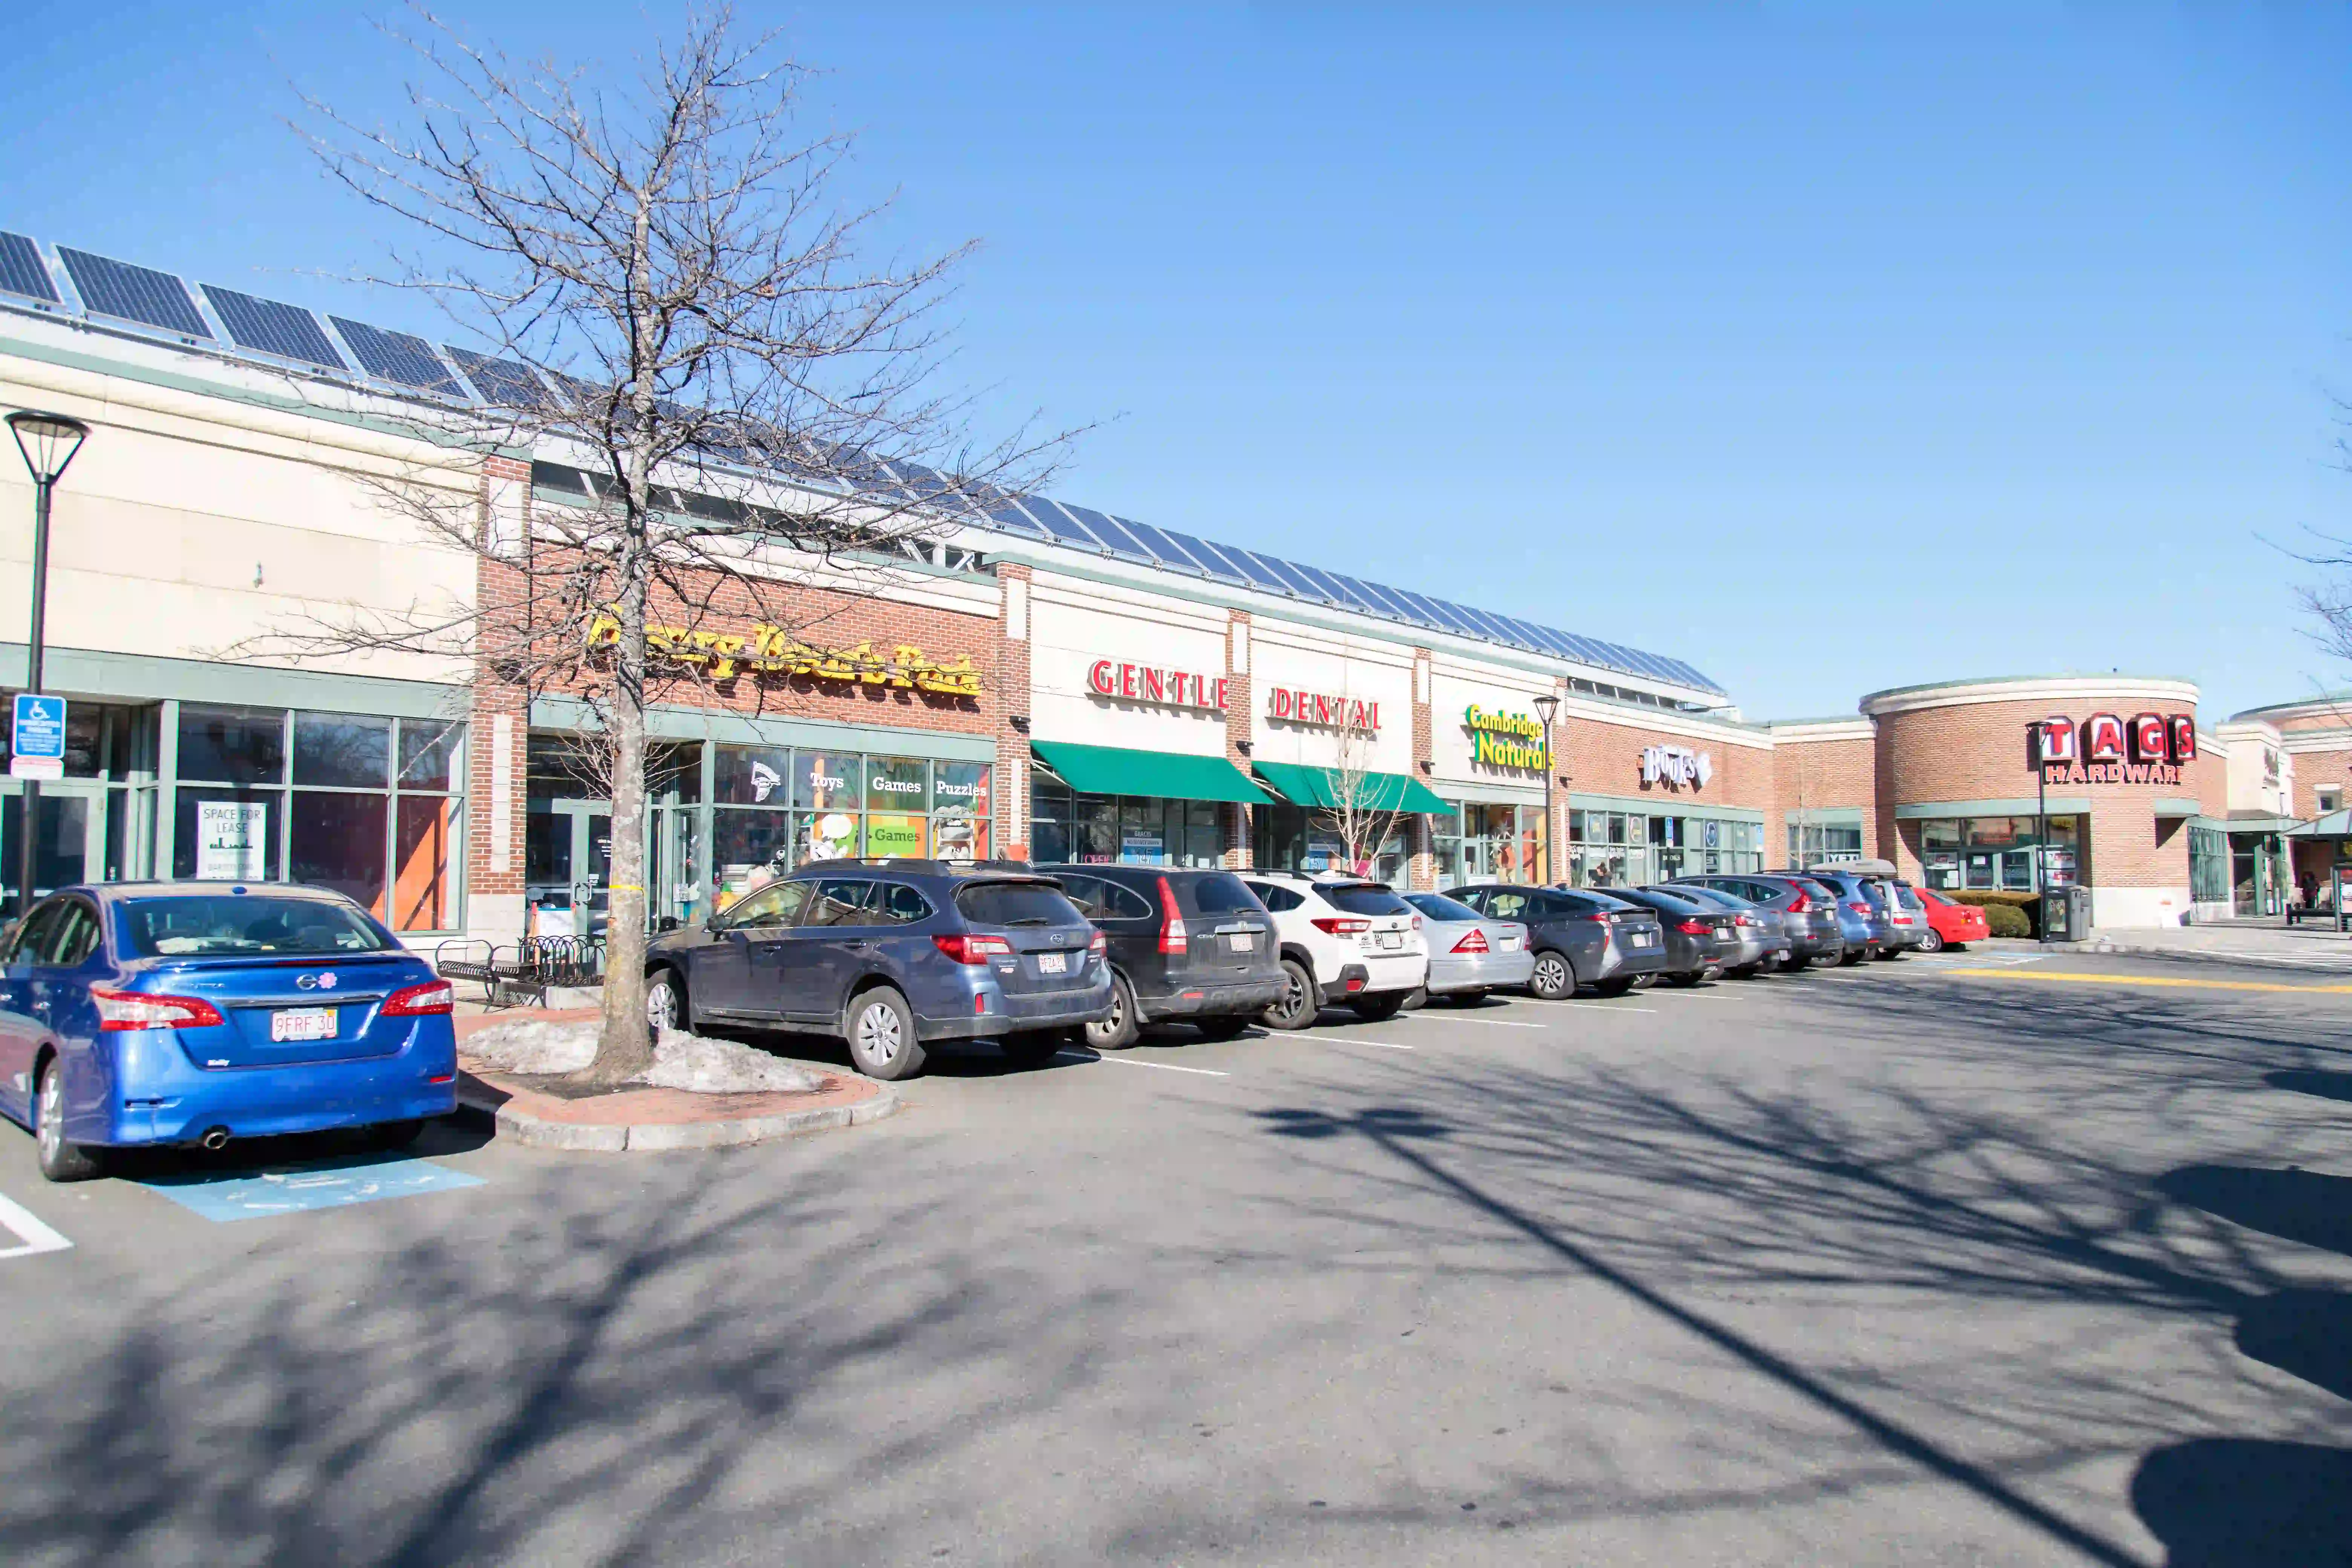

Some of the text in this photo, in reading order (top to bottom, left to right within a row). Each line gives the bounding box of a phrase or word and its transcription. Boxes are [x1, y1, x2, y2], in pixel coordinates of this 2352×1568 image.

[1089, 660, 1230, 709] GENTLE
[1273, 687, 1381, 729] DENTAL
[1466, 704, 1544, 741] Cambridge
[2044, 717, 2196, 758] TAGS
[810, 772, 844, 791] Toys
[872, 777, 922, 793] Games
[936, 781, 987, 797] Puzzles
[204, 809, 261, 819] SPACE FOR
[216, 823, 248, 833] LEASE
[276, 1017, 312, 1033] 9FRF
